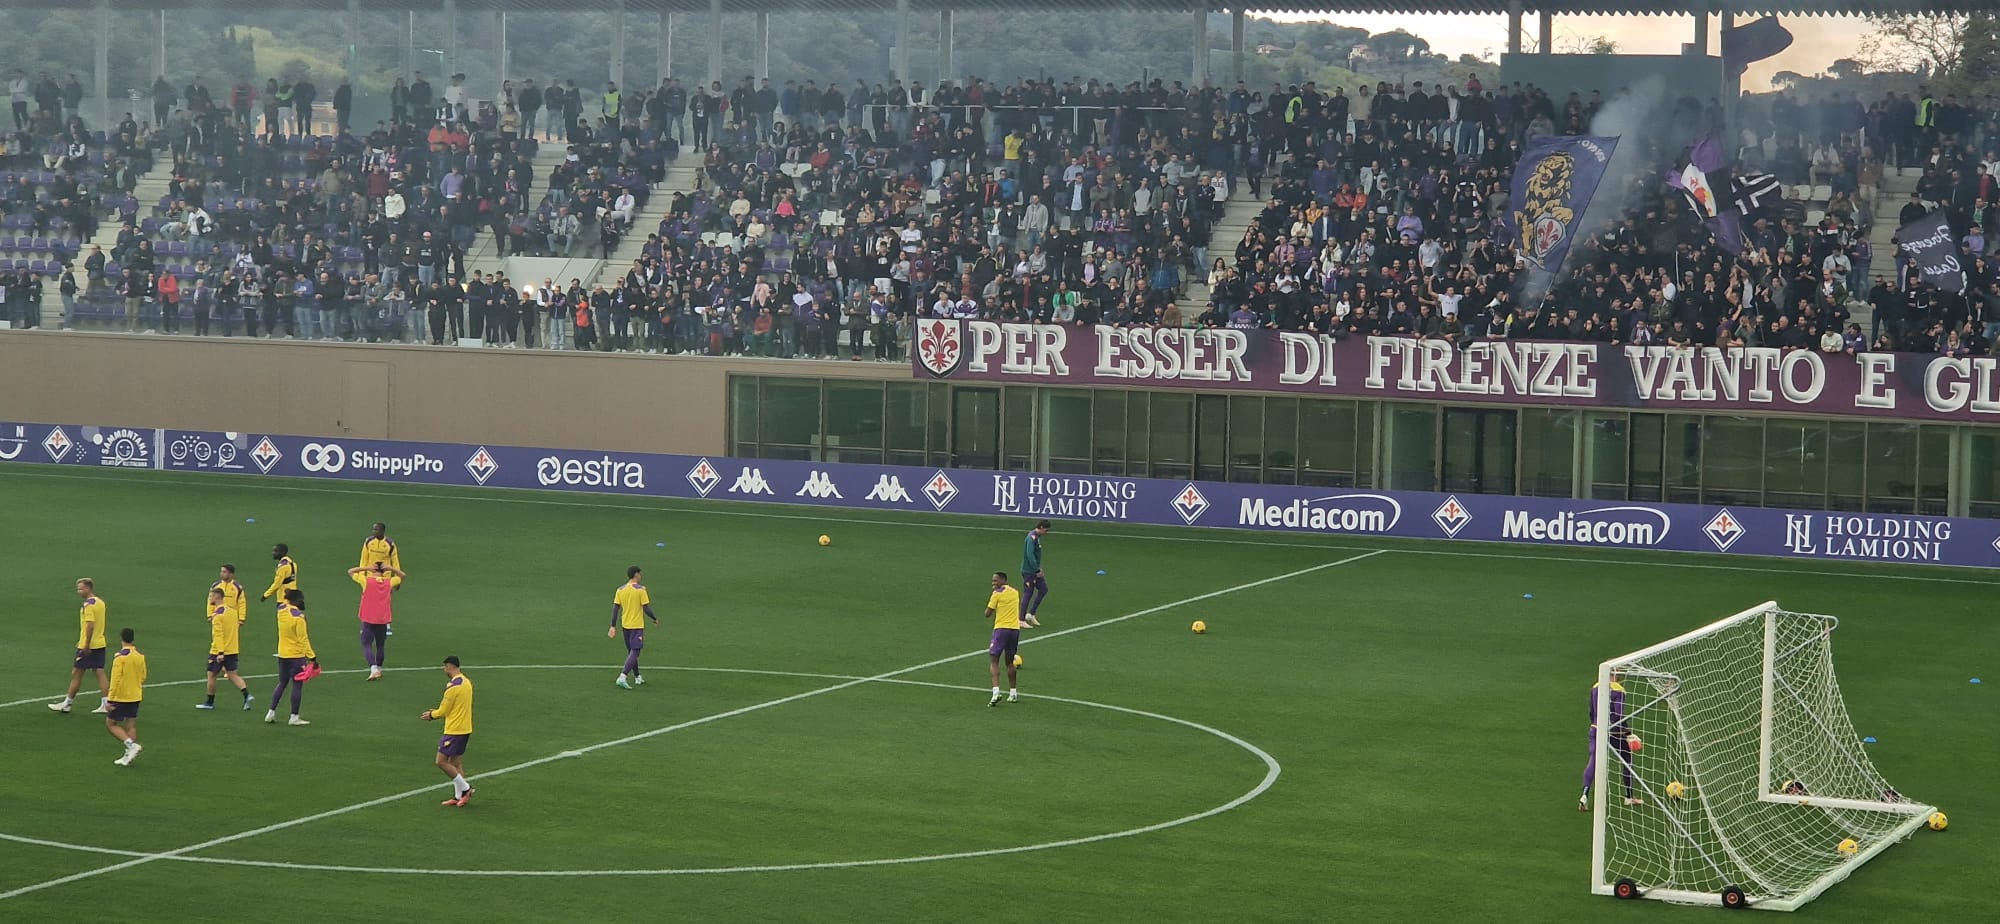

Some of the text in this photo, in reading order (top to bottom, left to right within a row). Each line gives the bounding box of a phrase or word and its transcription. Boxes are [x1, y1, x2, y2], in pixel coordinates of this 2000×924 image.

[968, 320, 1069, 376] PER
[1094, 324, 1252, 382] ESSER
[1279, 333, 1337, 387] DI
[1365, 335, 1597, 397] FIRENZE
[1624, 346, 1826, 404] VANTO
[1855, 353, 1896, 409] E
[101, 429, 148, 456] SAMMONTANA
[351, 450, 444, 476] ShippyPro
[562, 456, 645, 488] estra
[1028, 477, 1137, 500] HOLDING
[1028, 496, 1128, 519] LAMIONI
[1239, 497, 1386, 532] Mediacom
[1502, 509, 1654, 545] Mediacom
[1825, 516, 1952, 541] HOLDING
[1825, 536, 1941, 561] LAMIONI
